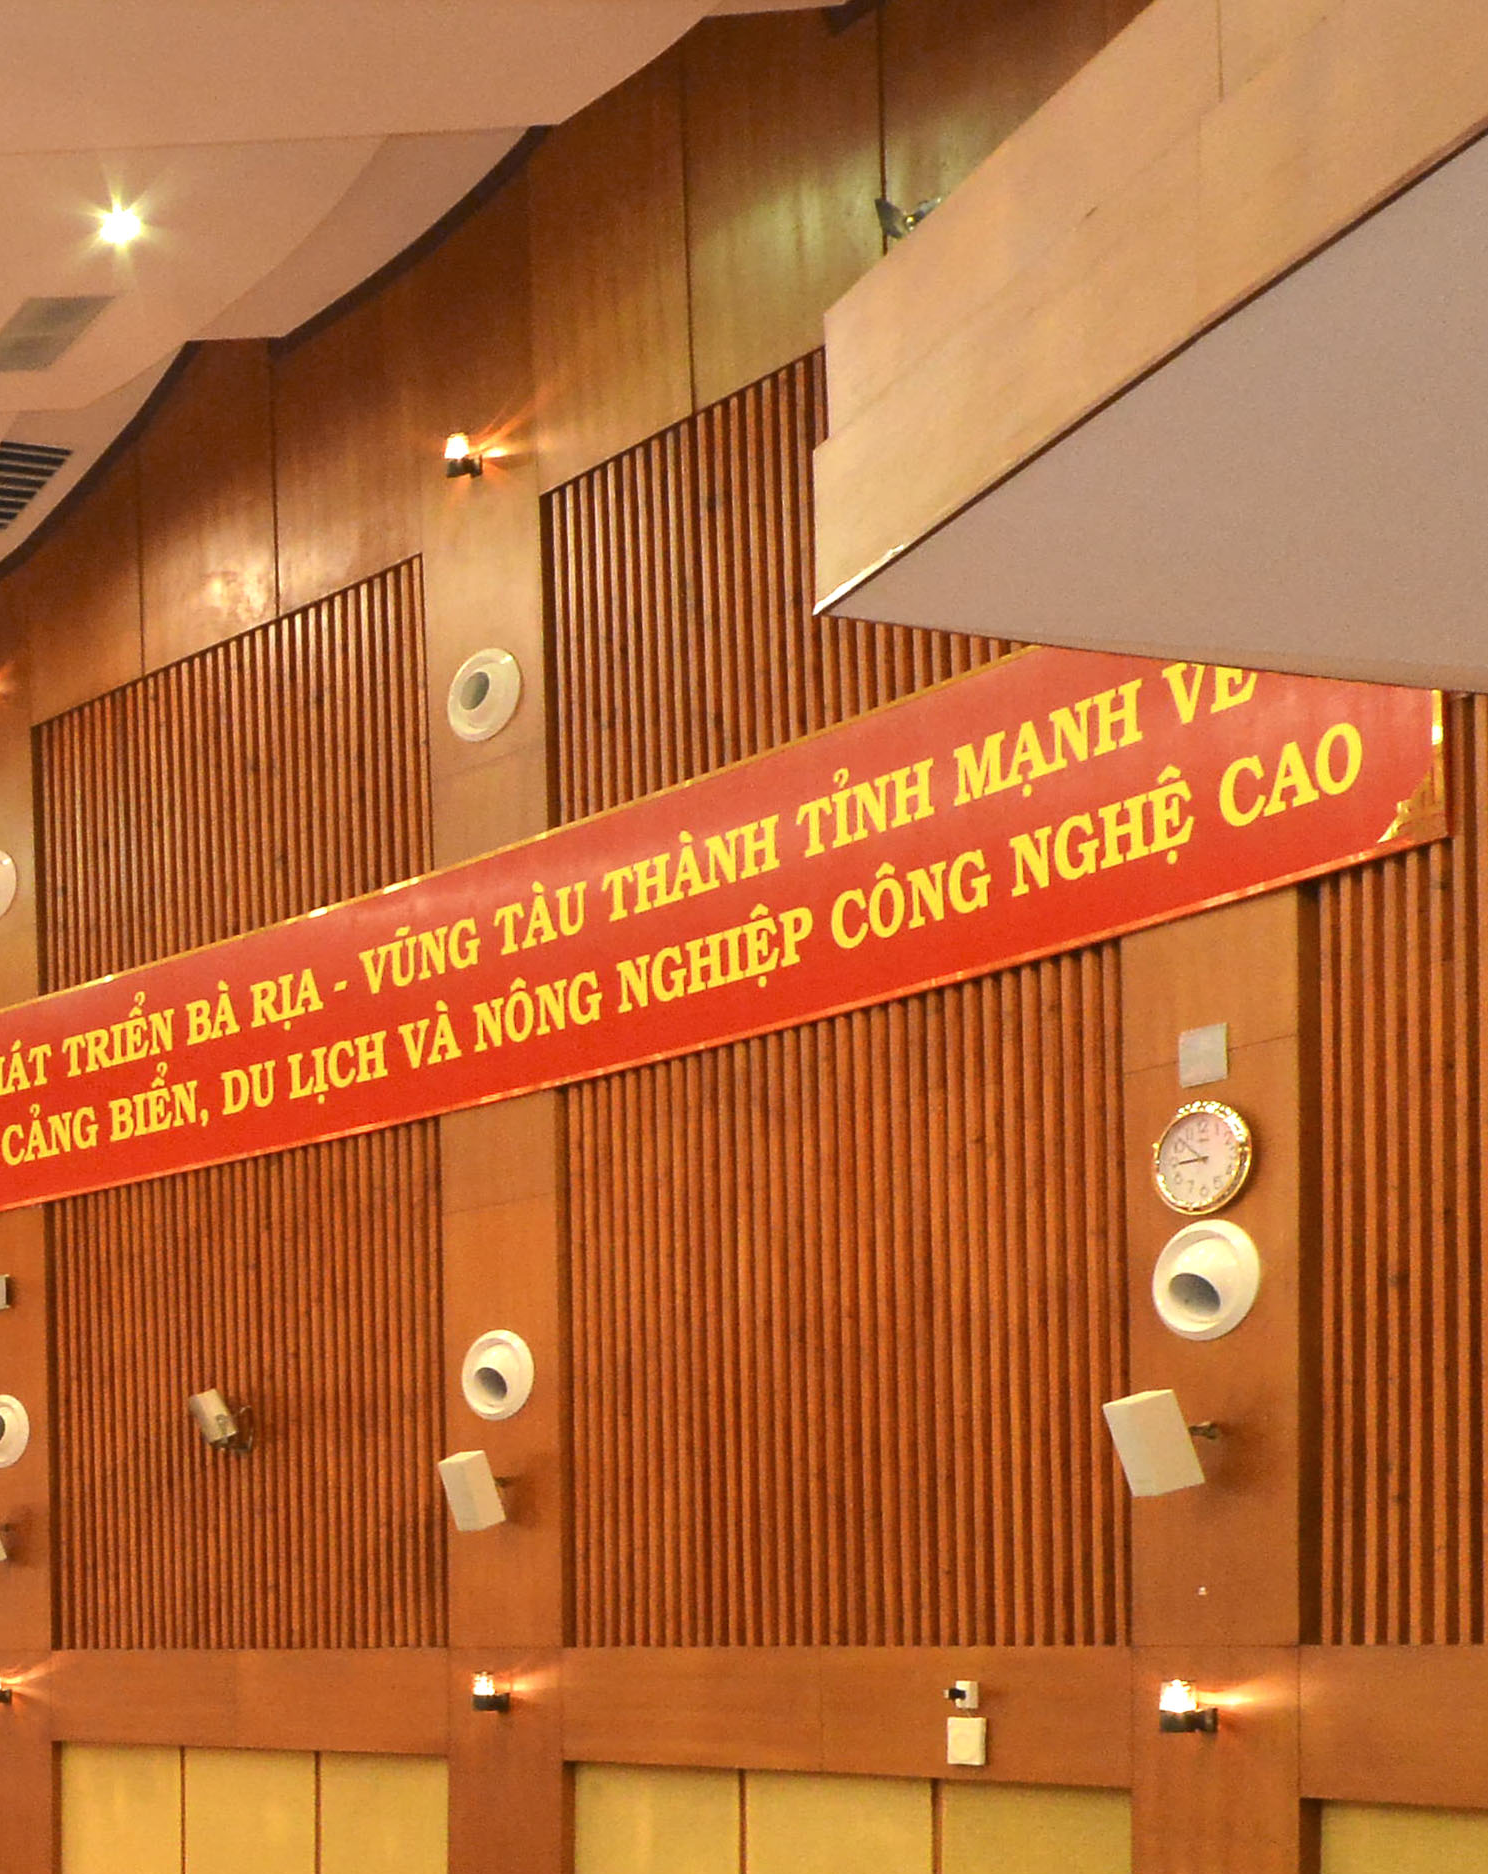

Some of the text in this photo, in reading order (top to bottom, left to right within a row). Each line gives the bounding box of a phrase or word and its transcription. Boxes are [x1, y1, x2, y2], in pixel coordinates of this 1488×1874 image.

[3, 1105, 99, 1166] CẢNG
[110, 1069, 209, 1142] BIỂN,
[223, 1062, 276, 1115] DU
[289, 1032, 389, 1104] LỊCH
[400, 1001, 462, 1069] VÀ
[474, 972, 603, 1052] NÔNG
[618, 905, 814, 1013] NGHIỆP
[832, 851, 992, 949] CÔNG
[1011, 766, 1195, 897] NGHỆ
[1220, 723, 1363, 827] CAO
[64, 1009, 175, 1077] TRIỂN
[187, 982, 240, 1046] BÀ
[252, 970, 324, 1030] RỊA
[360, 919, 481, 994] VŨNG
[495, 882, 588, 955] TÀU
[602, 815, 780, 922] THÀNH
[797, 759, 935, 858] TỈNH
[955, 680, 1144, 807] MẠNH
